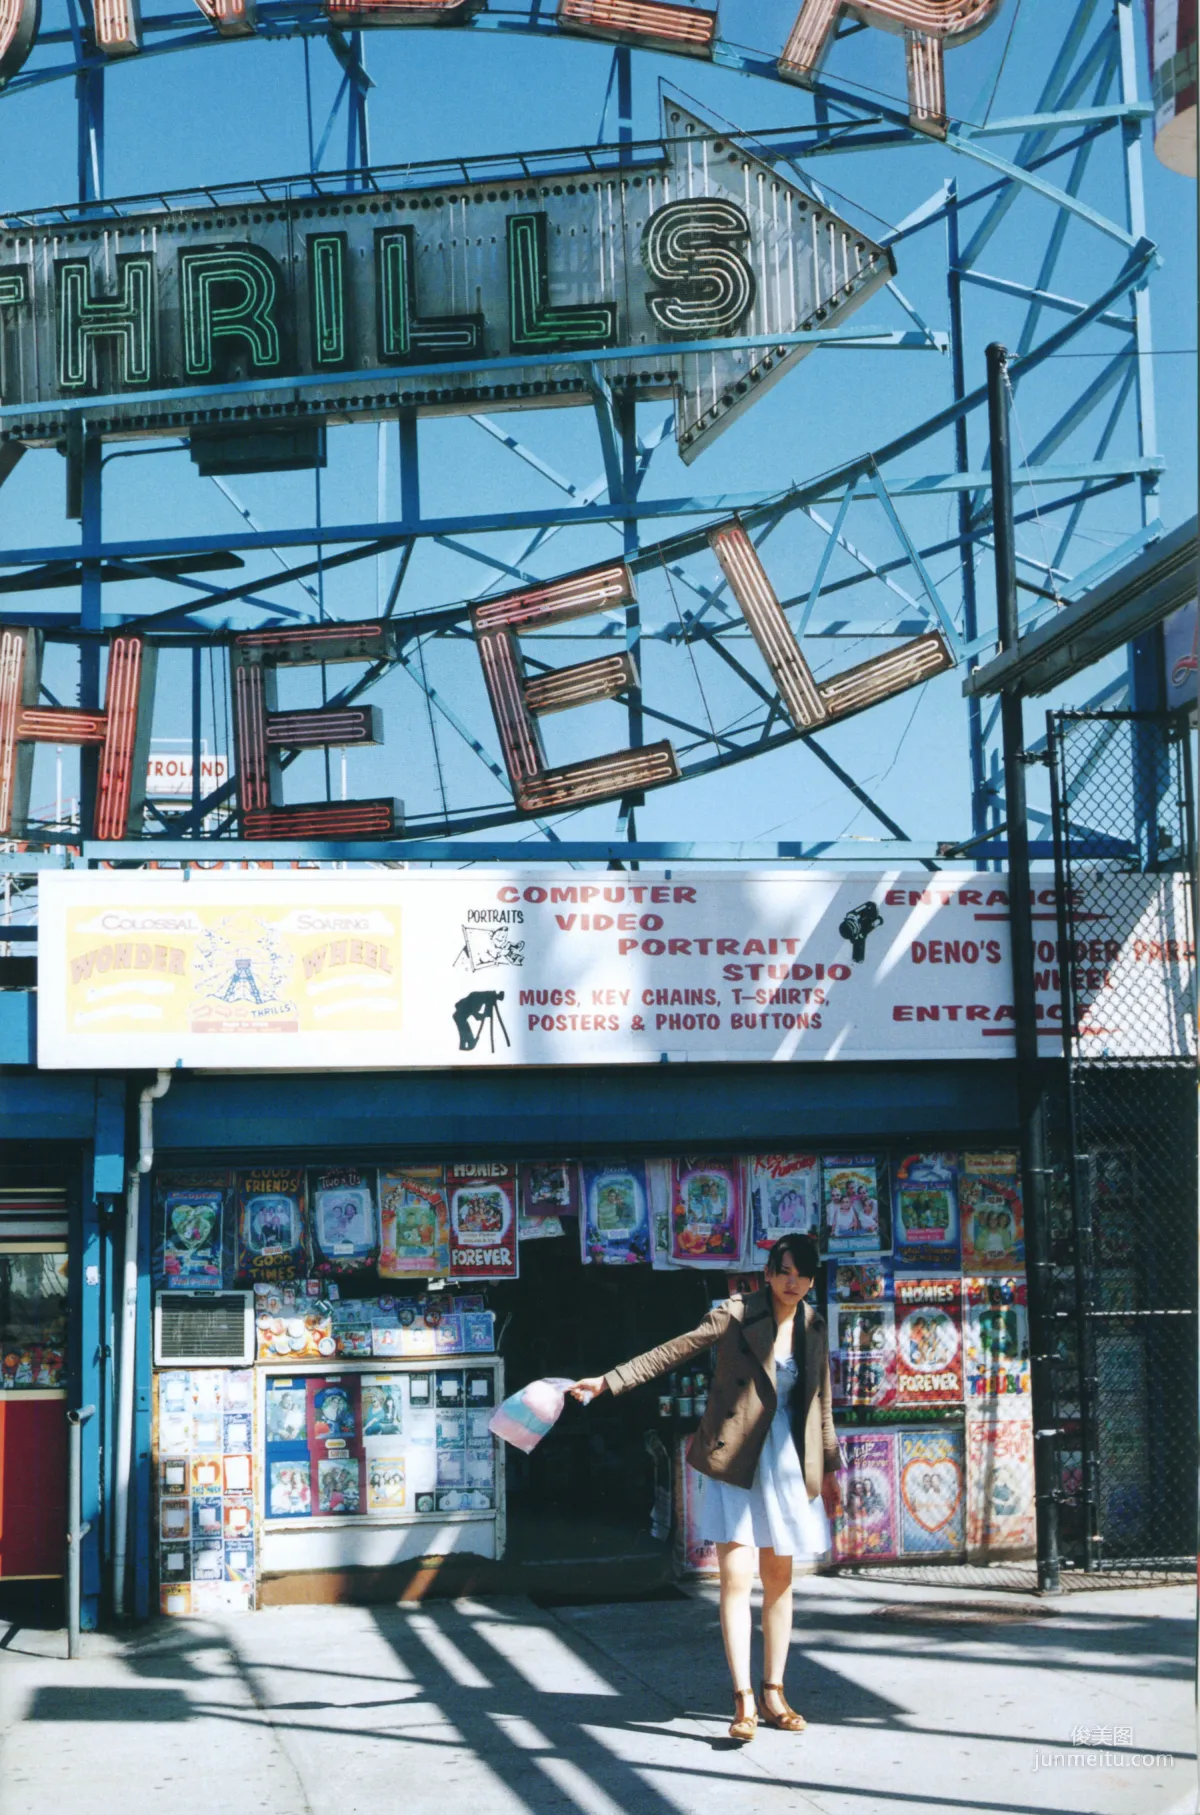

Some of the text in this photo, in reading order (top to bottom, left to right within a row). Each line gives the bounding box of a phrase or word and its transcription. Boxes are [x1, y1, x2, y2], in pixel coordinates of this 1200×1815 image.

[147, 760, 225, 777] TROLND
[496, 886, 697, 904] COMPUTER
[467, 909, 524, 924] PORTRAITS
[555, 913, 664, 932] VIDEO
[618, 938, 801, 956] PORTRAIT
[911, 940, 1002, 964] DENO'S
[70, 942, 187, 984] WONDER
[302, 938, 395, 980] WHEEL
[722, 963, 852, 982] STUDIO
[519, 988, 830, 1008] MUGS, KEY CHAINS, T-SHIRTS,
[528, 1012, 822, 1031] POSTERS & PHOTO BUTTONS
[246, 1178, 298, 1193] FRIENDS
[253, 1254, 292, 1268] GOOD
[452, 1248, 512, 1266] FOREVER
[251, 1266, 296, 1280] TIMES
[901, 1284, 955, 1304] HOMIES
[899, 1371, 960, 1394] FOREVER
